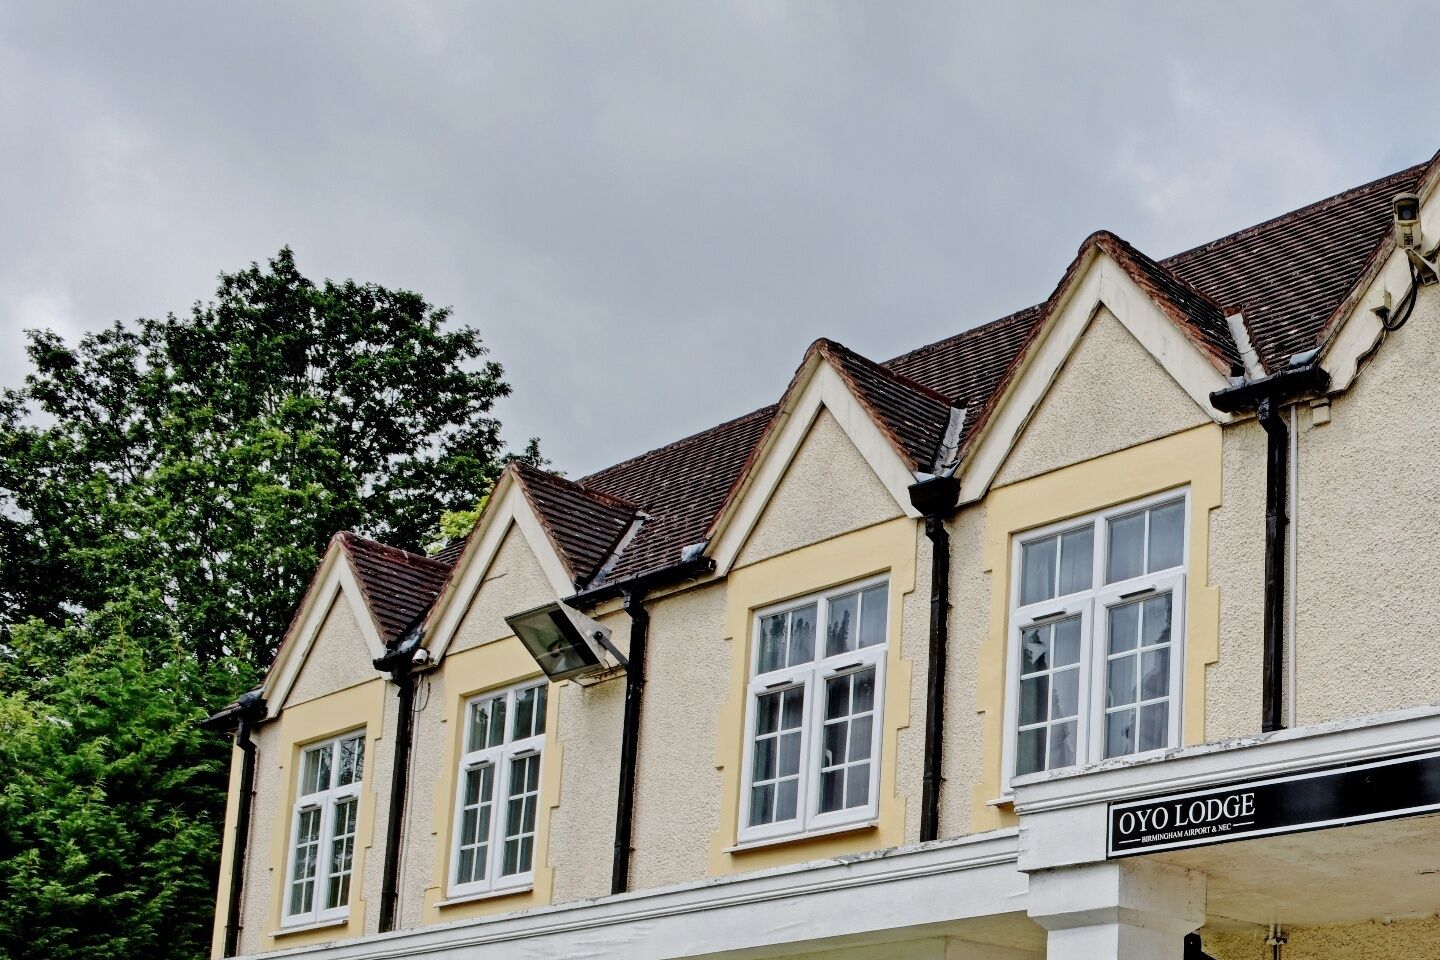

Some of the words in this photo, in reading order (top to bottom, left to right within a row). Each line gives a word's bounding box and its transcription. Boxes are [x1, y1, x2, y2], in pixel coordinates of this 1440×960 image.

[1119, 806, 1169, 835] OYO
[1174, 792, 1256, 827] LODGE
[1141, 830, 1184, 843] BIRMINGHAM
[1184, 825, 1211, 837] AIRPORT
[1211, 825, 1217, 833] &
[1218, 823, 1232, 832] NEC
